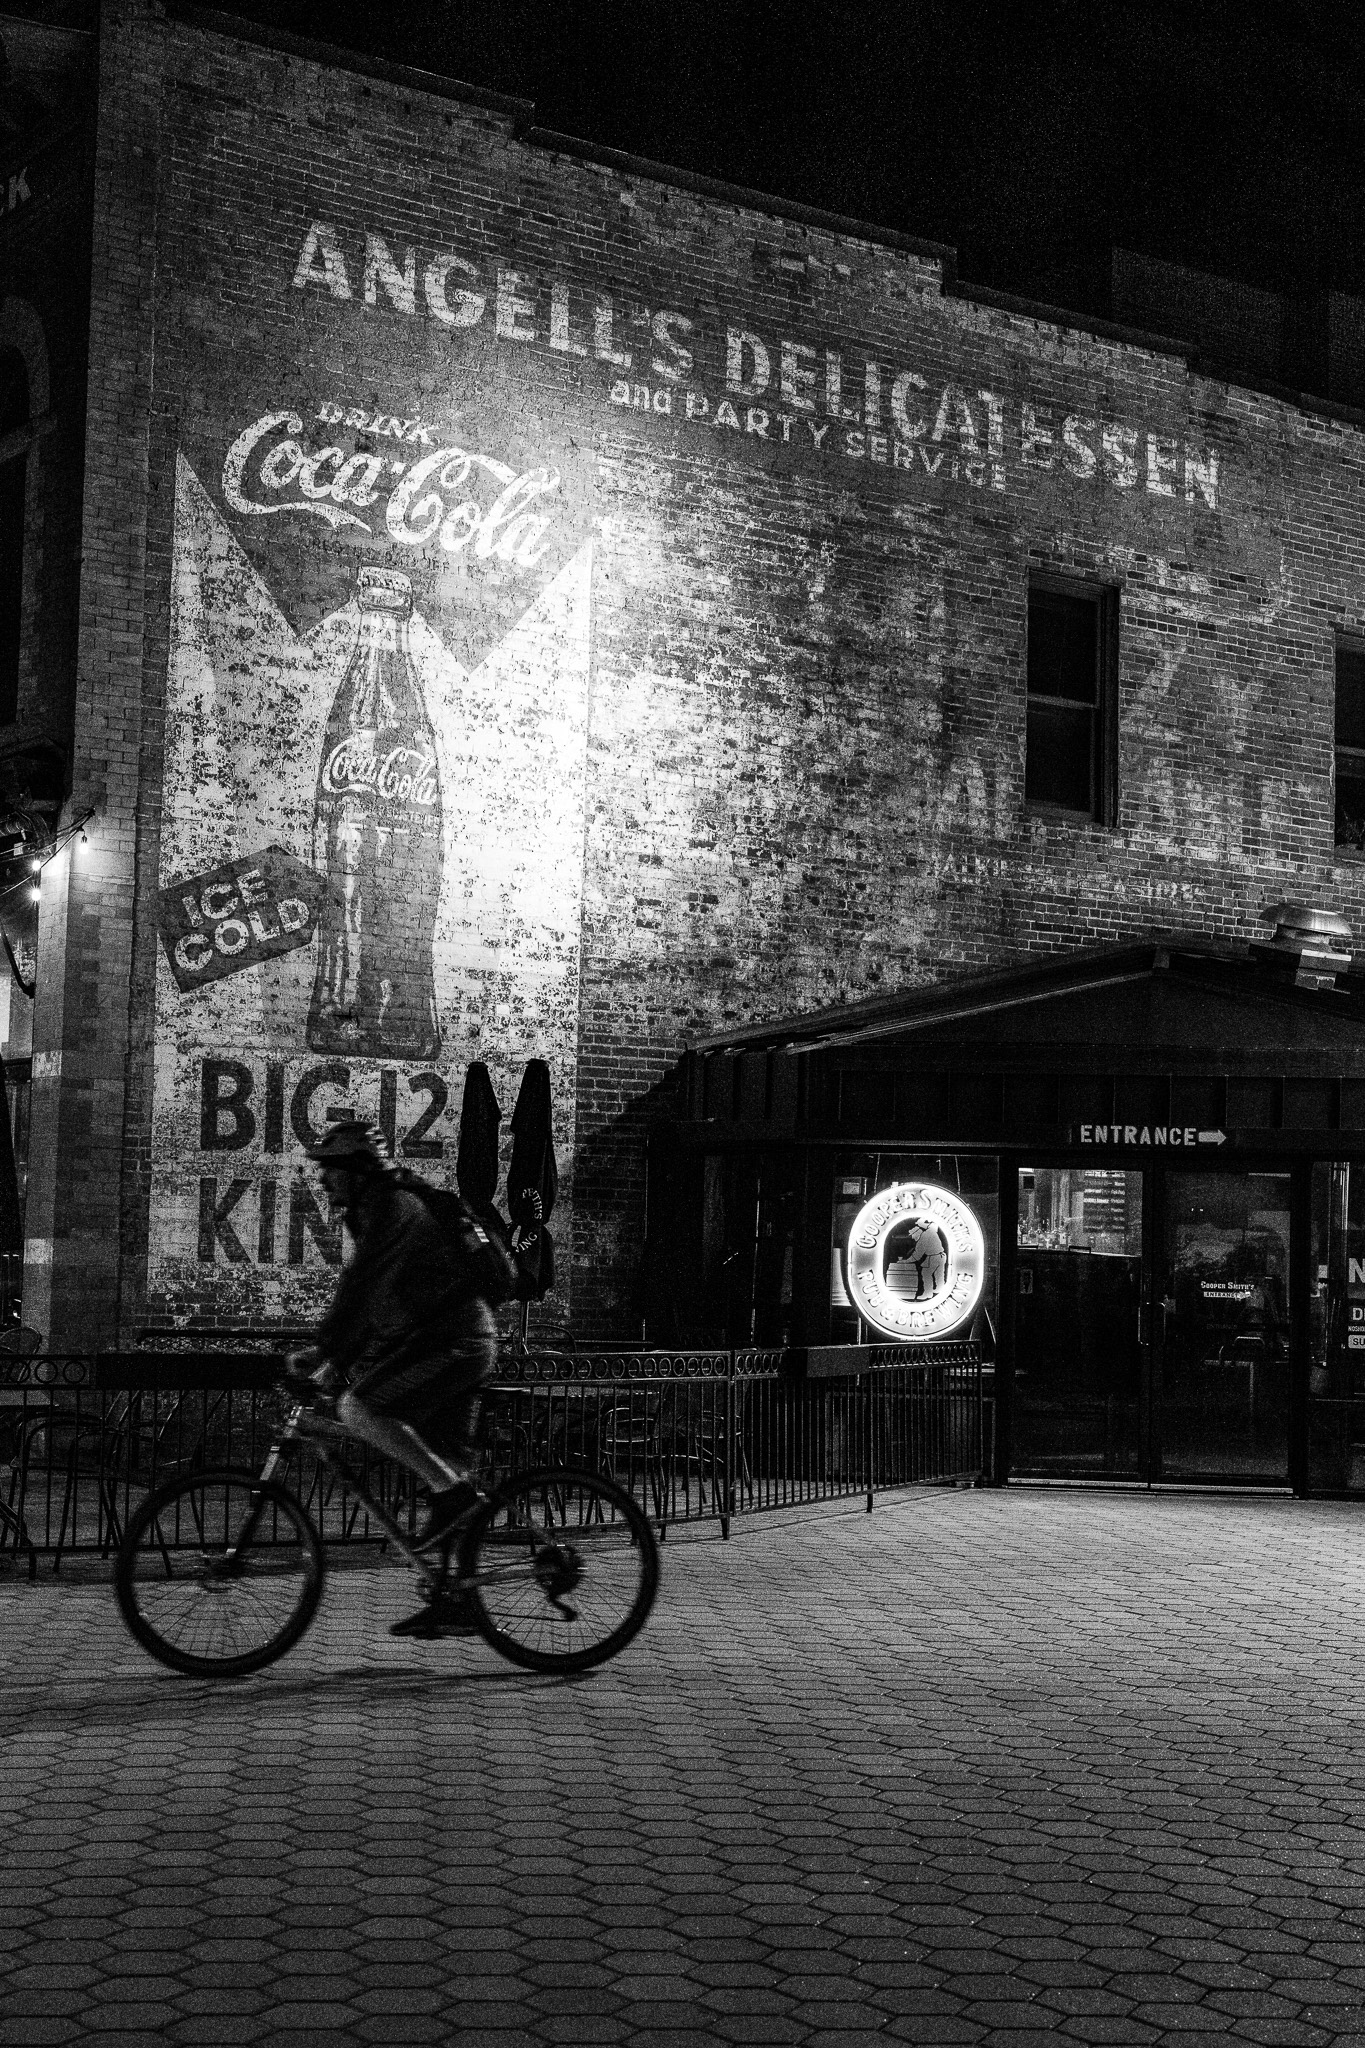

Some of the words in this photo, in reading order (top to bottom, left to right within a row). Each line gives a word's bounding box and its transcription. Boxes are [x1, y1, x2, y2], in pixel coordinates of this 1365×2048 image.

[0, 166, 32, 217] K
[292, 220, 694, 380] ANGELL'S
[726, 323, 1219, 509] DELICATESSEN
[315, 401, 446, 446] DRINK
[610, 380, 671, 414] and
[686, 391, 829, 449] PARTY
[846, 429, 1006, 491] SERVICE
[222, 411, 561, 567] Coca-Cola
[182, 869, 268, 928] ICE
[175, 899, 310, 971] COLD
[200, 1059, 356, 1154] BIG
[378, 1069, 448, 1159] 12
[1080, 1124, 1197, 1146] ENTRANCE
[198, 1177, 344, 1264] KIN
[857, 1269, 884, 1308] PUB
[894, 1272, 974, 1328] BREWING
[1201, 1281, 1226, 1289] COOPER
[1204, 1291, 1239, 1299] ENTRANC
[1352, 1307, 1365, 1321] D
